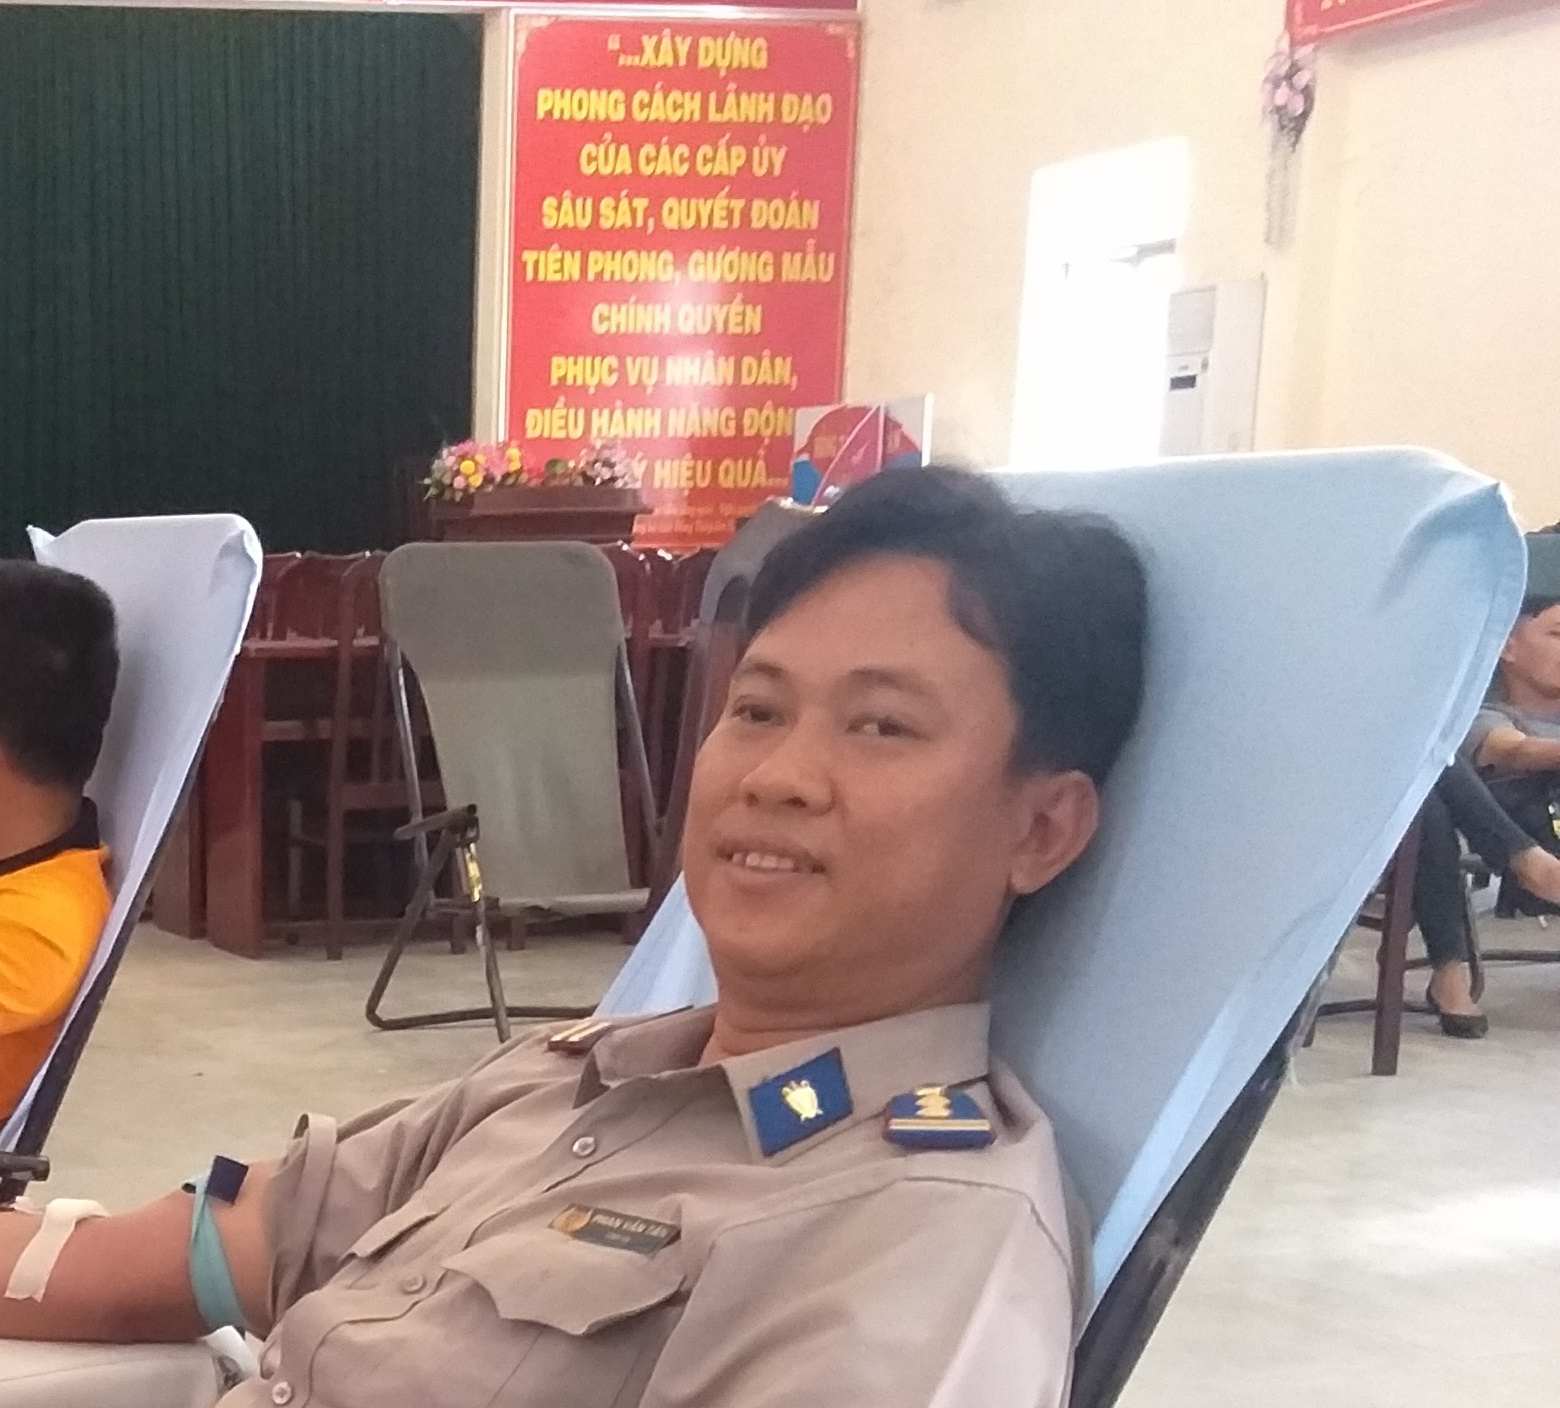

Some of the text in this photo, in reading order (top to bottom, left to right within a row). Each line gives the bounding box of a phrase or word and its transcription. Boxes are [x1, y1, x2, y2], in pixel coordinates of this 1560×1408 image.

[699, 34, 768, 76] DỰNG
[537, 82, 832, 132] PHONG CÁCH LÃNH ĐẠO
[579, 133, 787, 177] CỦA CÁC CẤP ỦY
[542, 187, 820, 233] SÂU SÁT, QUYẾT ĐOÁN
[521, 244, 580, 282] TIÊN
[588, 250, 680, 286] PHONG,
[592, 294, 671, 333] CHÍNH
[551, 347, 798, 393] PHỤC VỤ NHÂN DÂN,
[591, 400, 661, 438] HÀNH
[743, 399, 794, 444] ĐỘN
[653, 450, 710, 496] HIỆU
